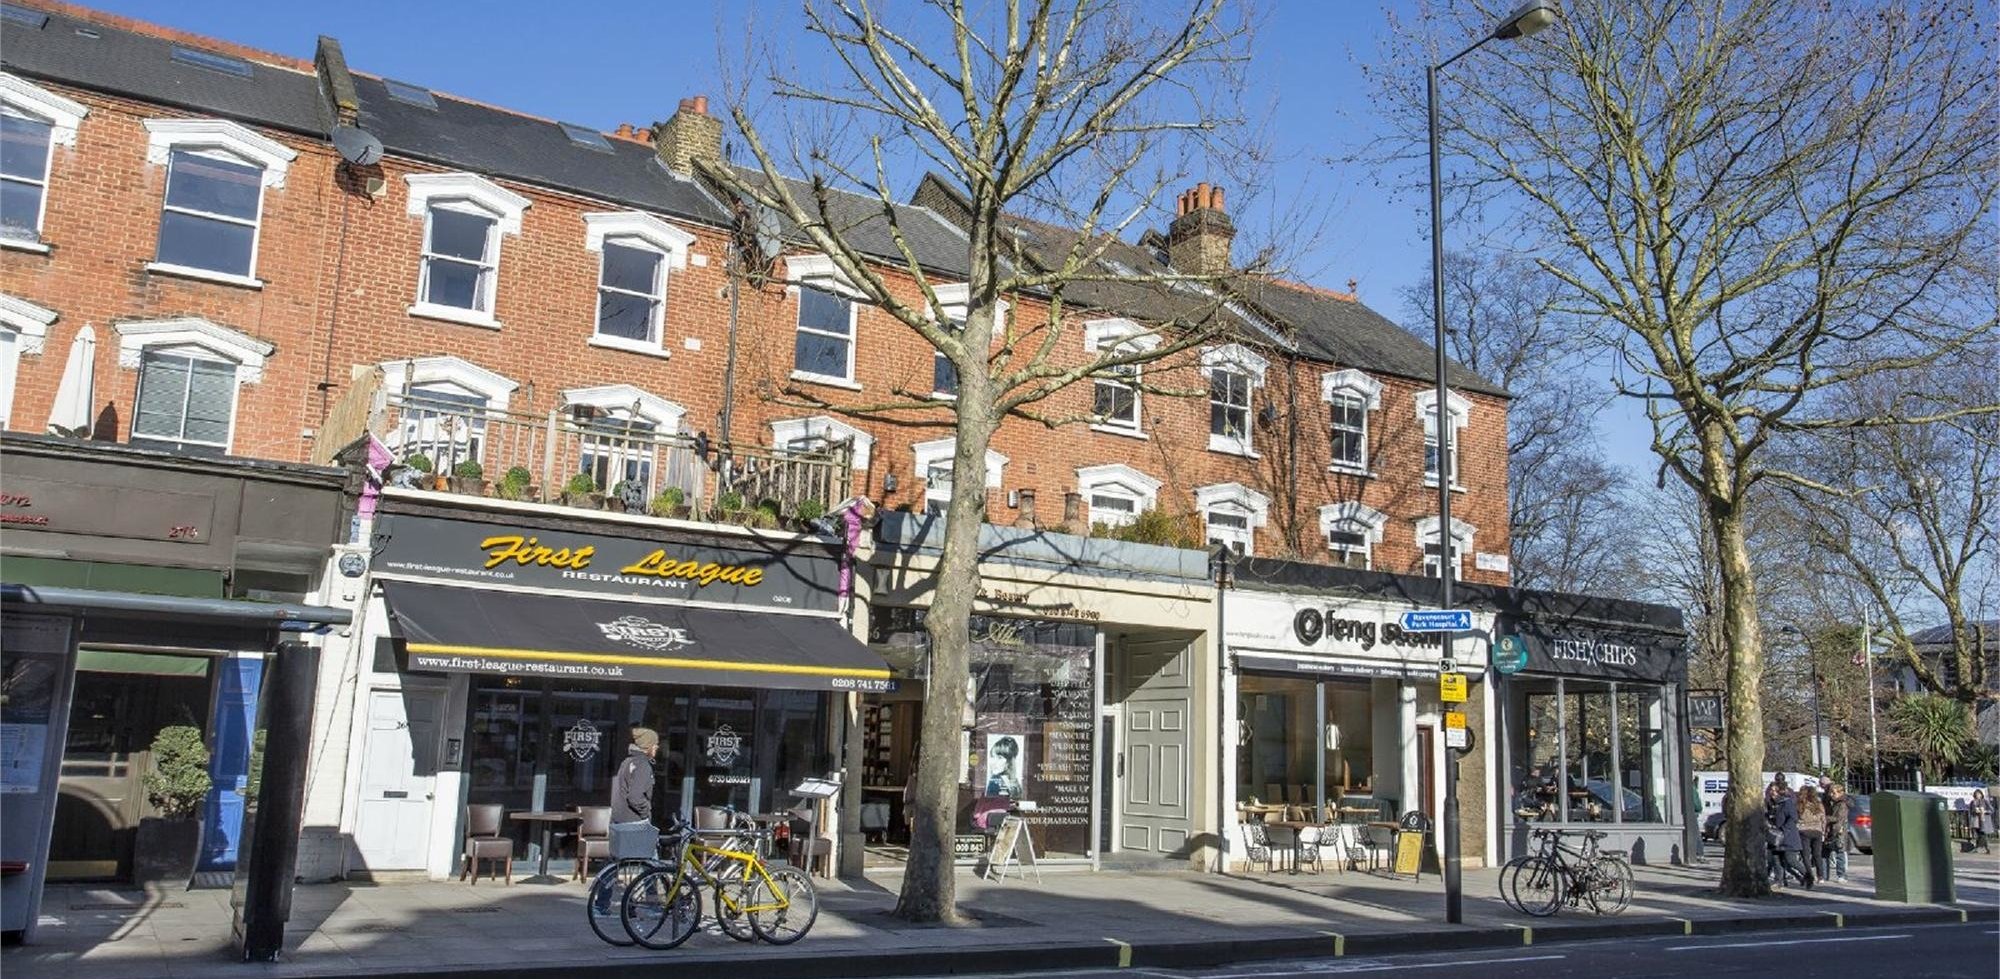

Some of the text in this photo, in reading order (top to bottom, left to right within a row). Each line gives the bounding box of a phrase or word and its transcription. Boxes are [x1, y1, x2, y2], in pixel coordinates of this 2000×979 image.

[480, 535, 763, 587] First League
[562, 570, 689, 589] RESTAURANT
[1412, 613, 1456, 621] Ravenscourt
[1324, 609, 1376, 652] feng
[1411, 620, 1459, 630] Park Hospital
[563, 731, 602, 743] FIRST
[706, 736, 742, 749] FIRST
